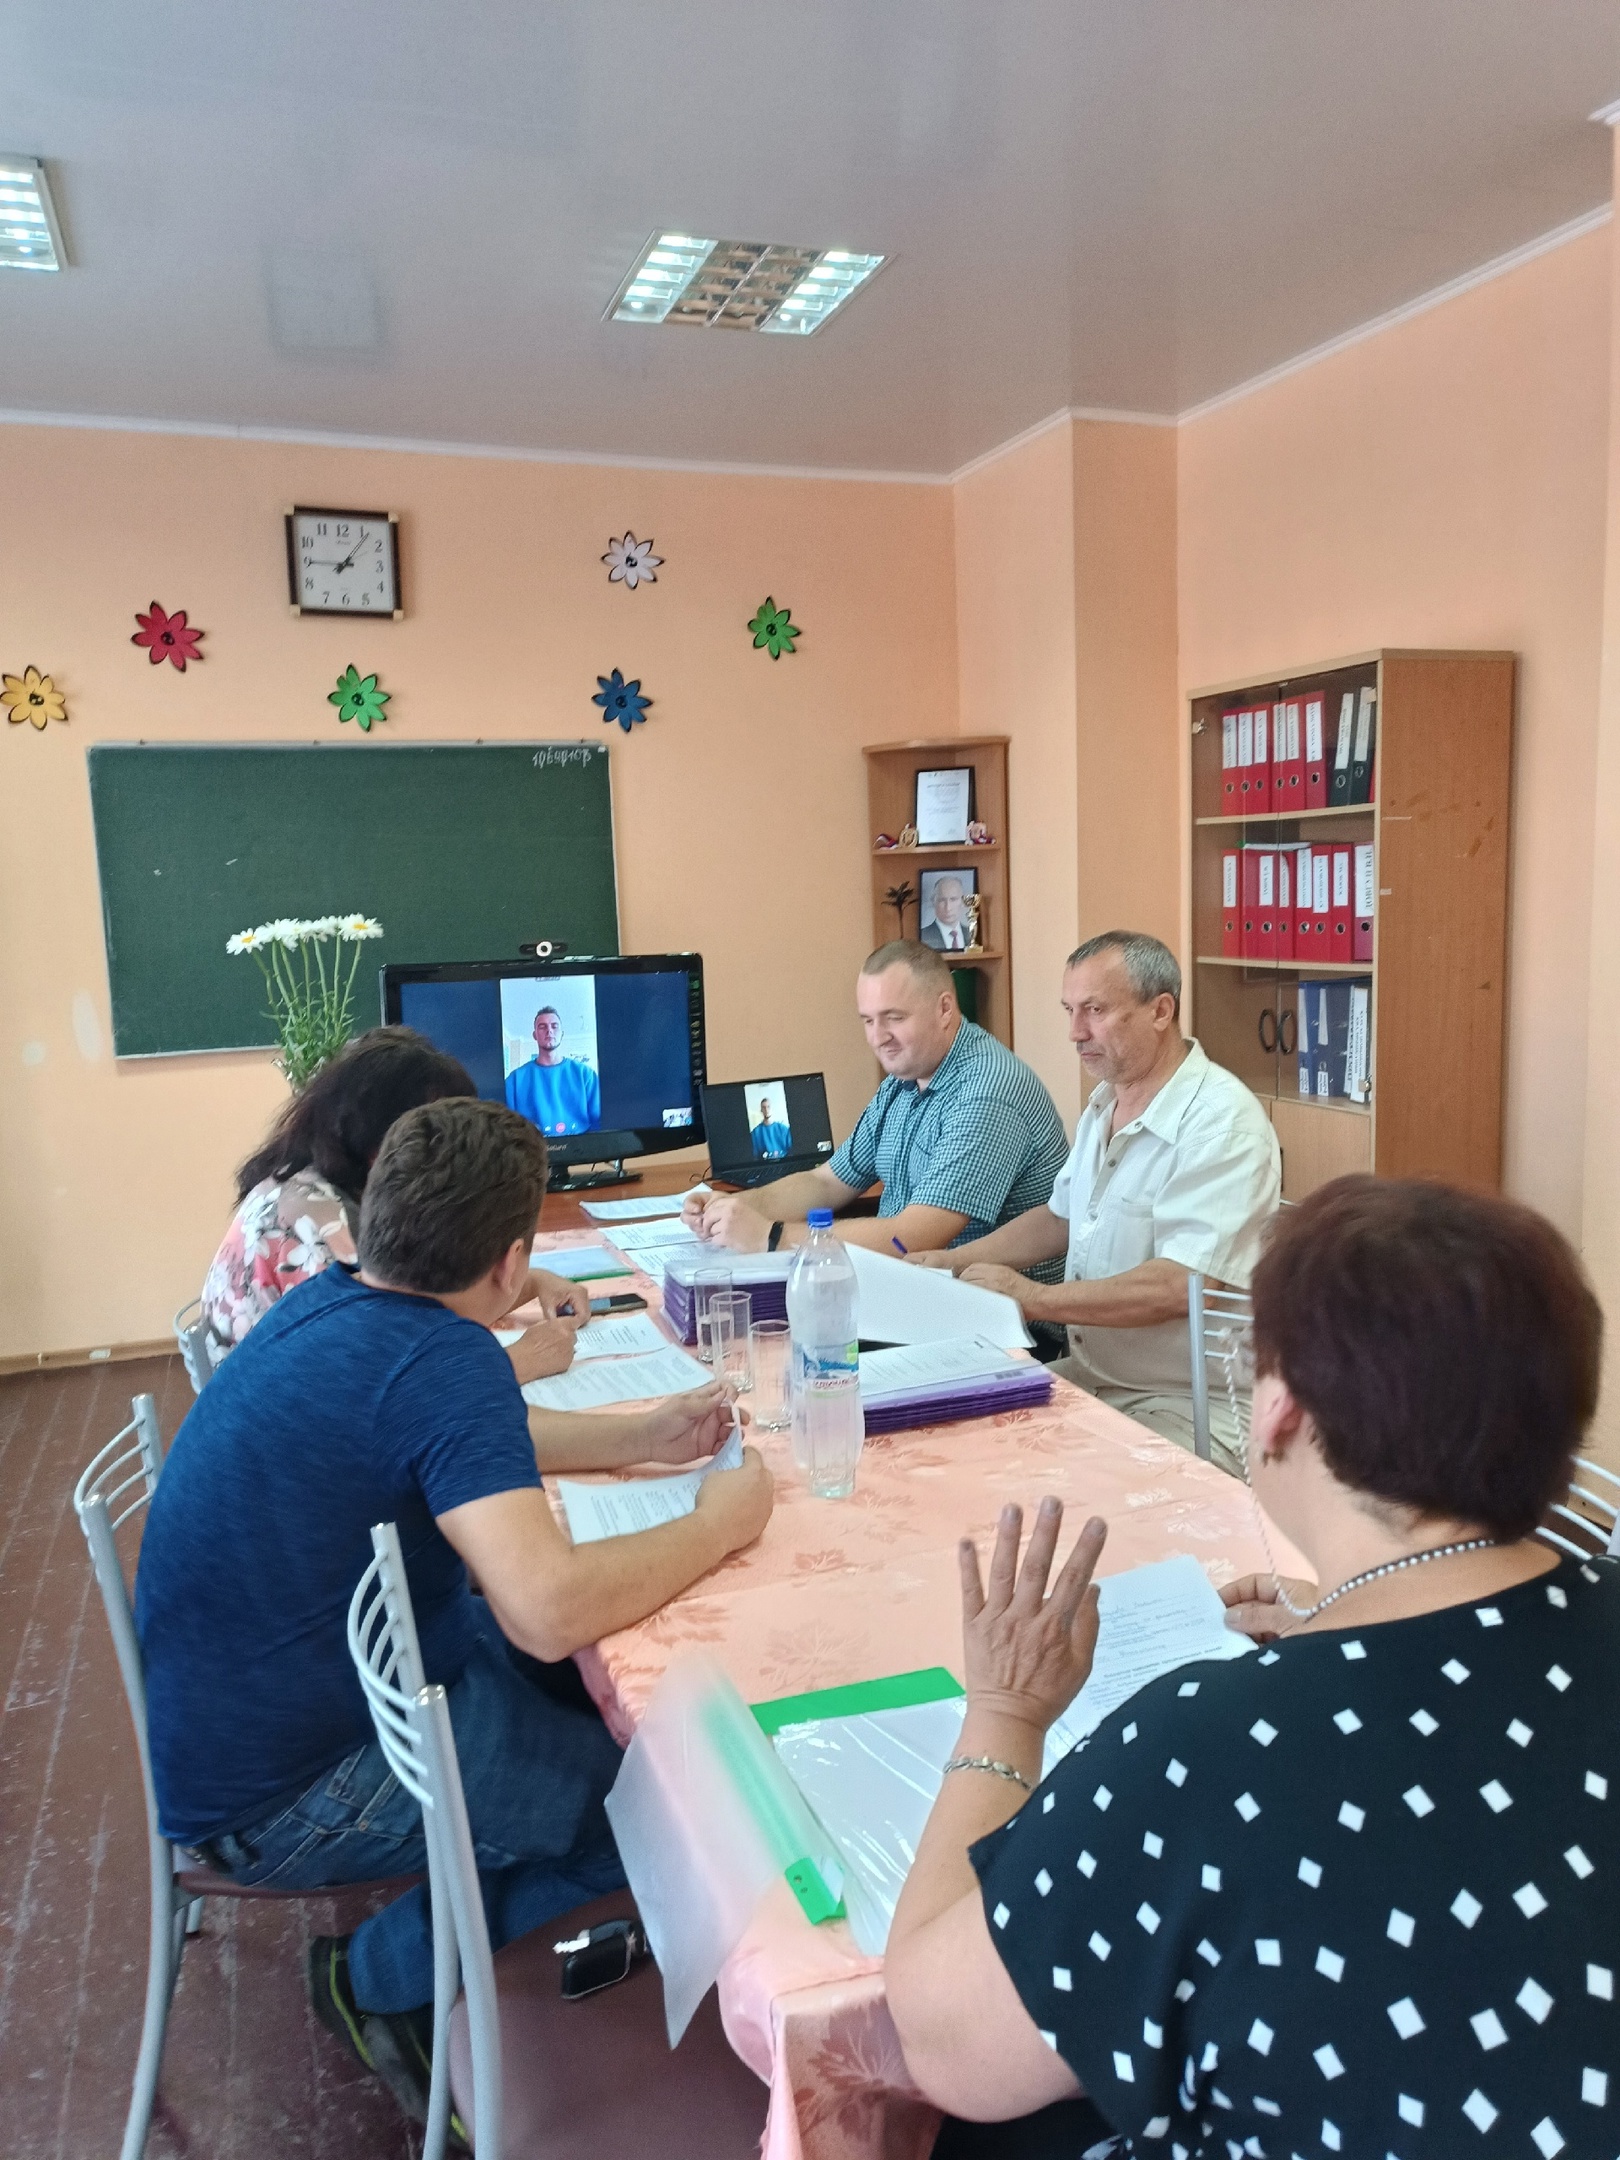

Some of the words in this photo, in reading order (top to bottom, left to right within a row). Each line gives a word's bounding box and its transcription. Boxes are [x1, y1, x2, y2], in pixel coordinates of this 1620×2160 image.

[317, 523, 327, 536] 11
[336, 523, 350, 538] 12
[301, 536, 314, 549] 10
[374, 539, 383, 553] 2
[304, 556, 312, 568] 9
[376, 560, 384, 573] 3
[305, 577, 314, 590] 8
[377, 581, 384, 593] 4
[322, 591, 330, 604] 7
[342, 593, 350, 605] 6
[362, 592, 370, 605] 5
